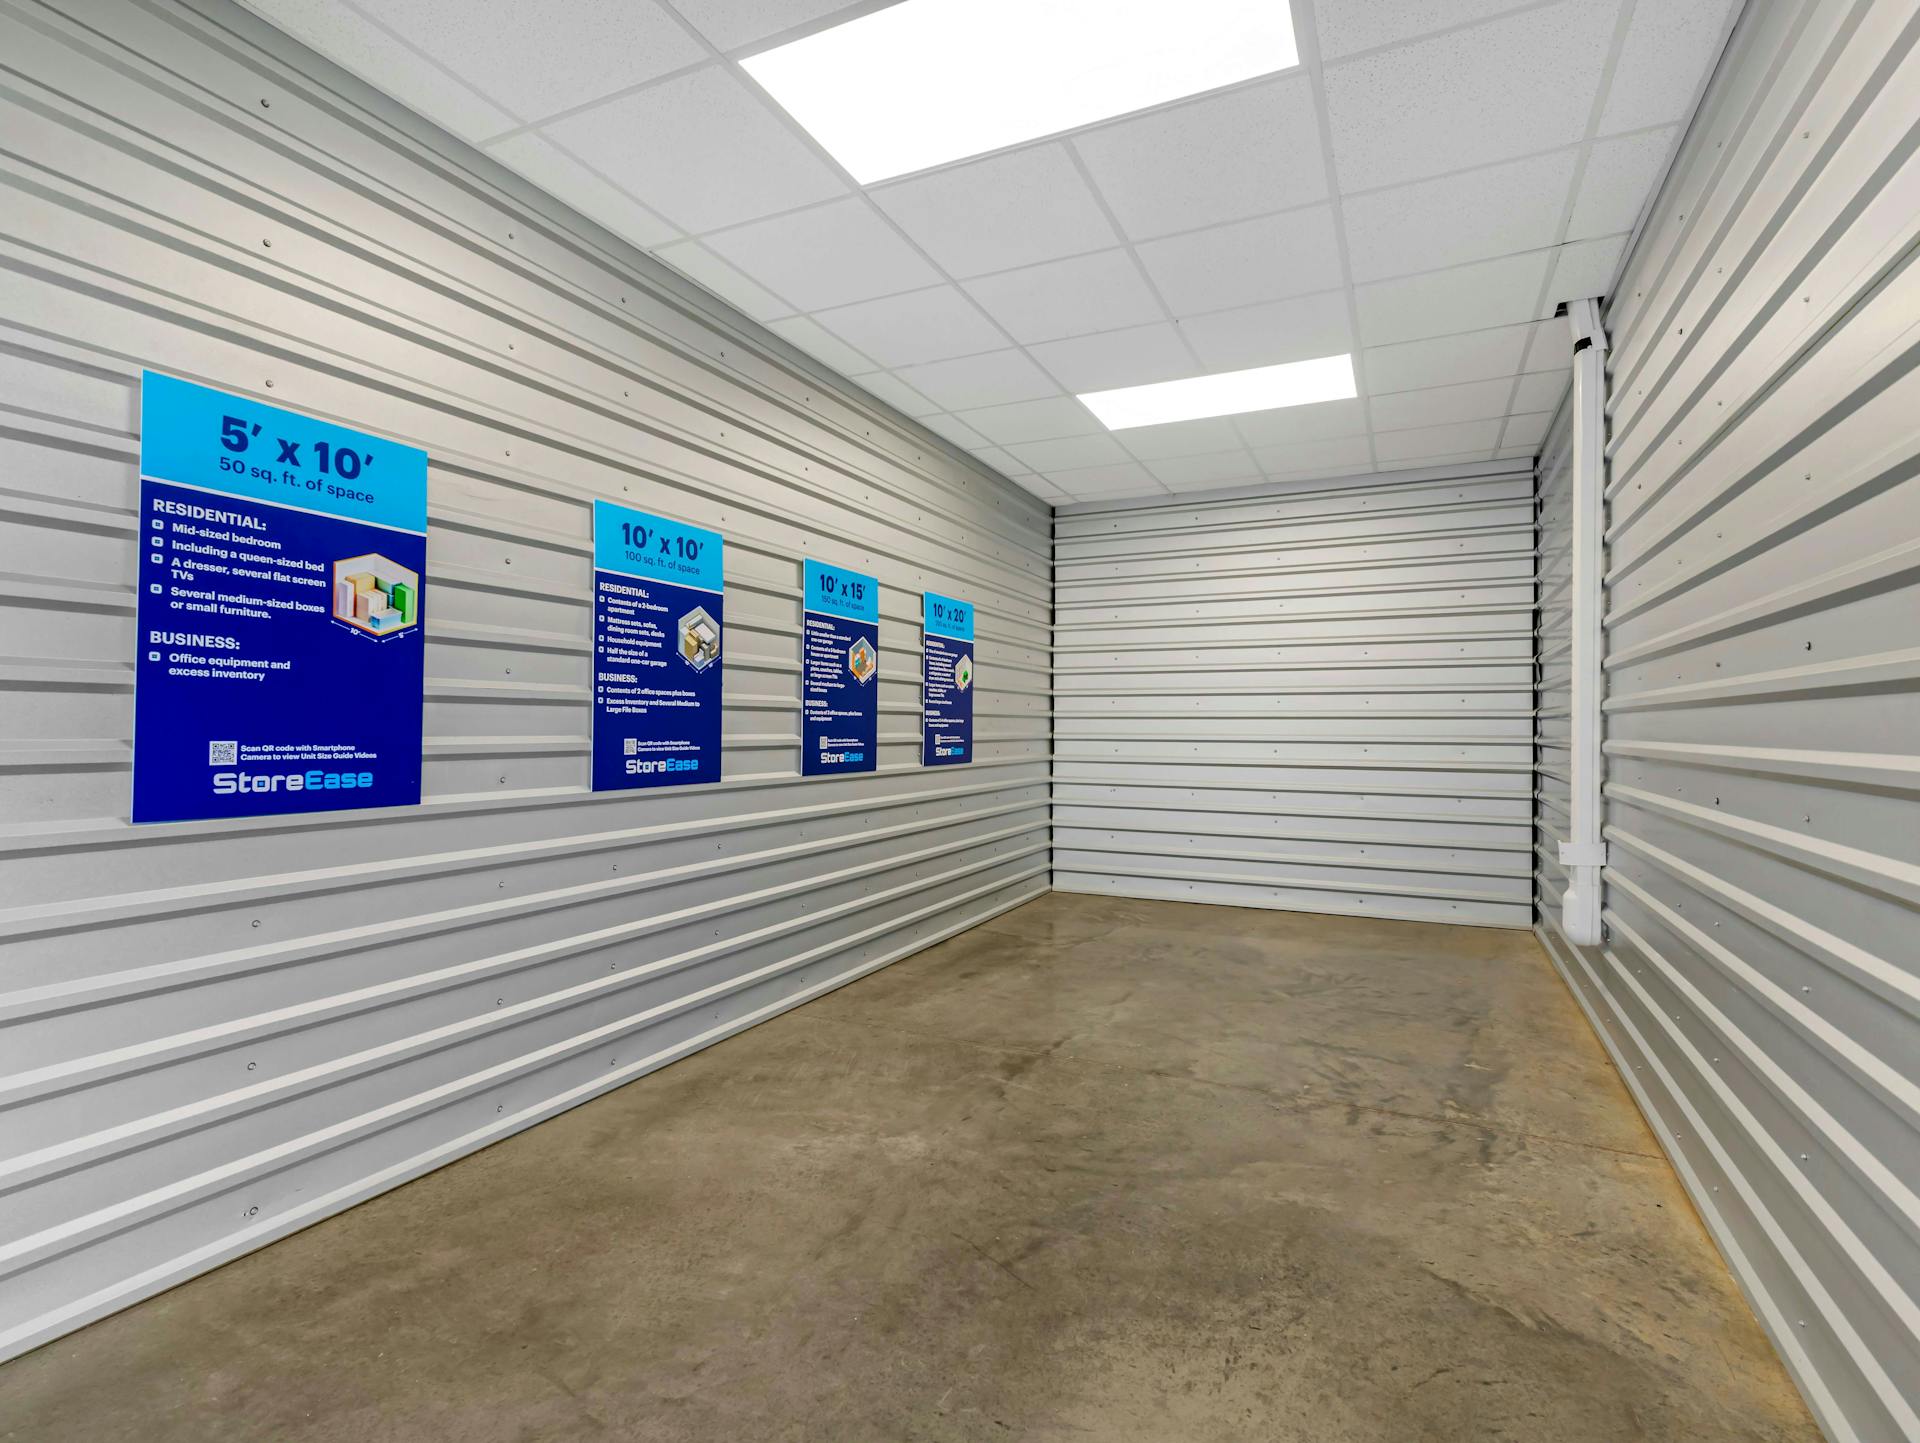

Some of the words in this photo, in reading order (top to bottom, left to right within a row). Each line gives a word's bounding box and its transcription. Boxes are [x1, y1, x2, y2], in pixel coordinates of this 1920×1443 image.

[220, 415, 262, 453] 5'
[276, 438, 301, 467] x
[314, 441, 374, 480] 10'
[219, 457, 246, 475] 50
[251, 467, 277, 485] sq.
[282, 472, 301, 488] ft.
[306, 479, 323, 492] of
[327, 485, 375, 504] space
[153, 499, 267, 531] RESIDENTIAL:
[172, 523, 230, 541] Mid-sized
[232, 532, 281, 550] bedroom
[622, 522, 654, 549] 10'
[659, 537, 671, 555] x
[676, 536, 704, 561] 10'
[172, 540, 228, 559] Including
[230, 550, 238, 559] a
[239, 552, 304, 569] queen-sized
[305, 560, 325, 573] bed
[625, 550, 642, 562] 100
[643, 555, 656, 567] sq.
[657, 557, 667, 568] ft.
[668, 560, 677, 570] of
[678, 563, 701, 575] space
[171, 557, 181, 567] A
[183, 559, 230, 575] dresser,
[232, 568, 272, 581] several
[273, 573, 291, 583] flat
[292, 576, 326, 588] screen
[171, 569, 194, 581] TVs
[599, 582, 649, 598] RESIDENTIAL:
[820, 574, 838, 593] 10'
[841, 584, 848, 597] x
[851, 582, 866, 600] 15'
[171, 586, 216, 601] Several
[217, 592, 294, 611] medium-sized
[295, 599, 326, 614] boxes
[170, 601, 184, 609] or
[186, 601, 217, 613] small
[219, 605, 271, 619] furniture.
[607, 607, 635, 615] apartment
[948, 610, 952, 621] x
[149, 630, 240, 650] BUSINESS:
[607, 636, 635, 645] Household
[636, 640, 662, 648] equipment
[169, 653, 206, 665] Office
[208, 657, 269, 669] equipment
[270, 661, 291, 670] and
[168, 666, 210, 677] excess
[211, 668, 265, 682] inventory
[598, 672, 638, 683] BUSINESS:
[240, 753, 272, 761] Camera
[282, 752, 300, 760] view
[301, 752, 316, 760] Unit
[317, 752, 332, 760] Size
[295, 744, 312, 752] with
[312, 744, 356, 752] Smartphone
[625, 758, 699, 774] StoreEase
[821, 752, 864, 764] StoreEase
[213, 770, 373, 795] StoreEase
